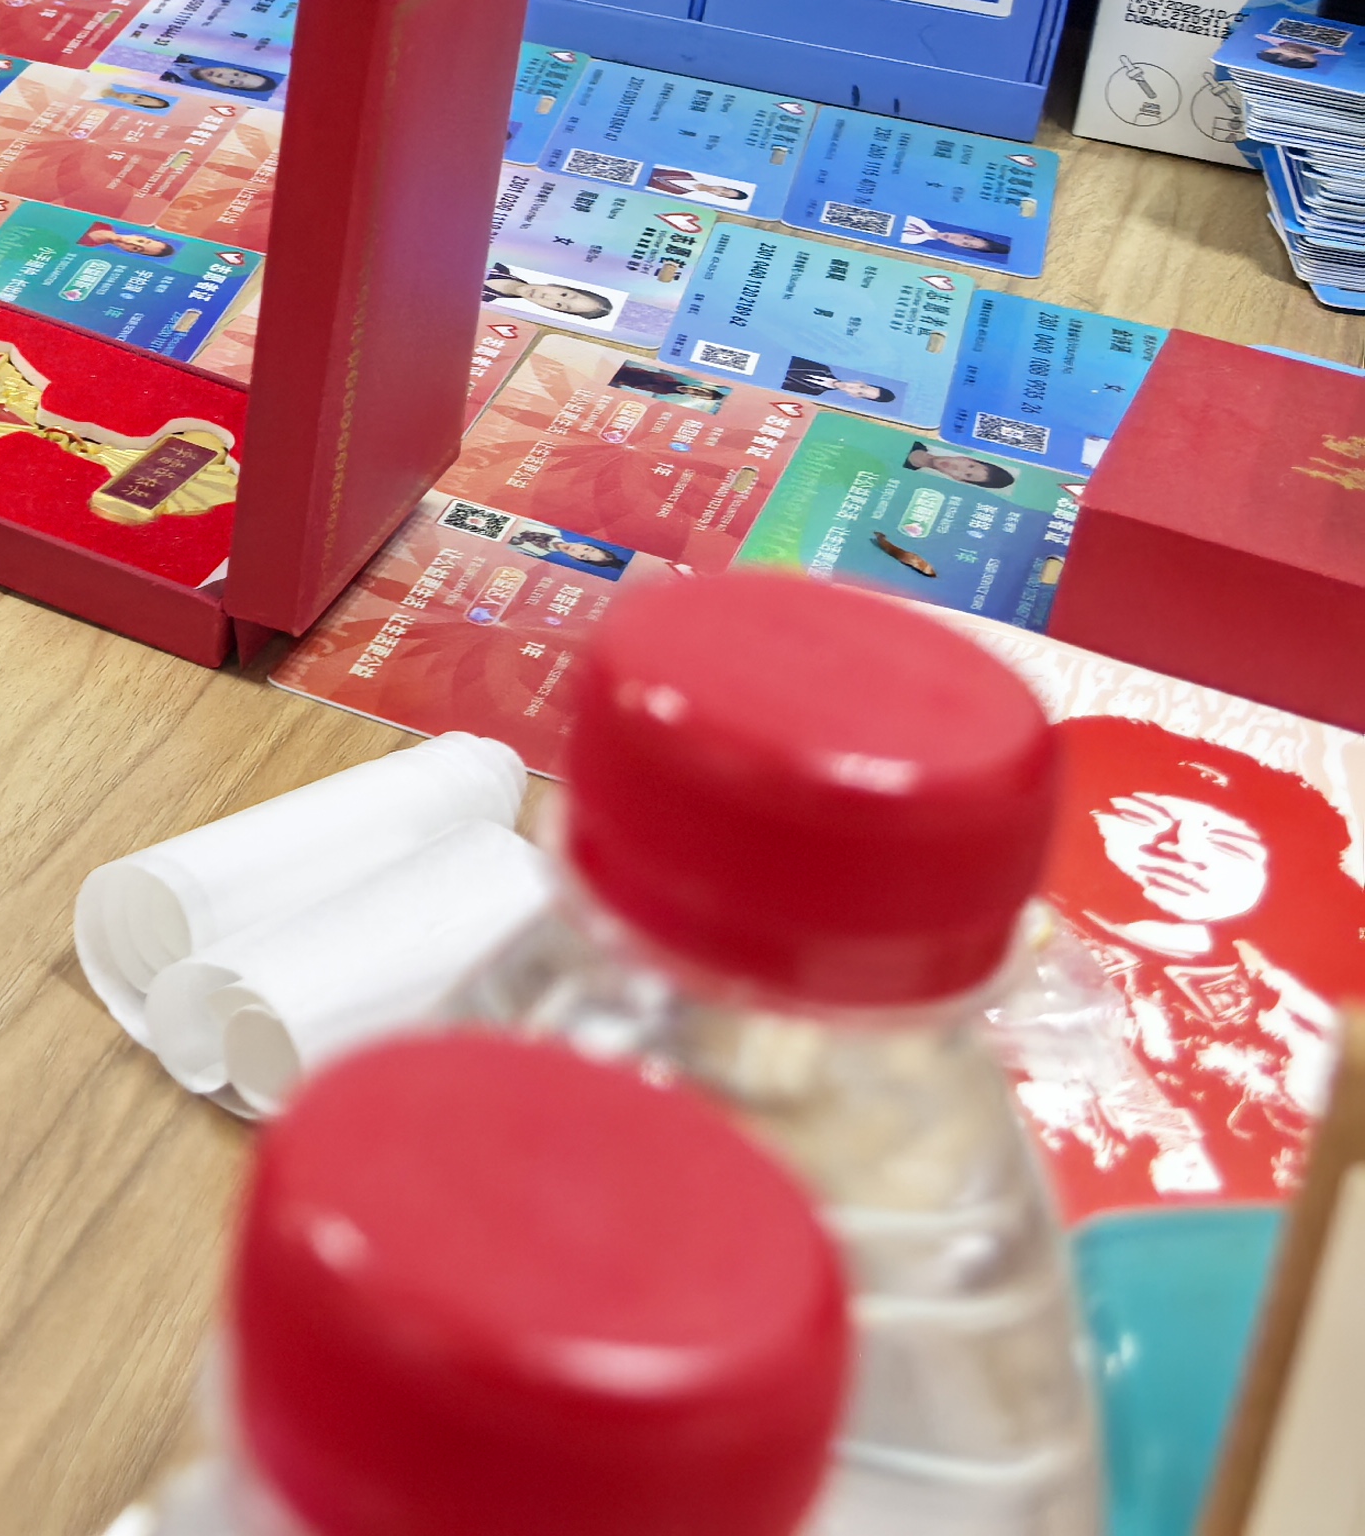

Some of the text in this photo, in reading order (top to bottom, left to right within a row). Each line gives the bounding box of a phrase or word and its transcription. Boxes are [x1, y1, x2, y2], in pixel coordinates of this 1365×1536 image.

[182, 114, 226, 146] 志愿者证
[103, 149, 127, 161] 1年
[495, 174, 529, 212] 2301 0200
[551, 234, 575, 247] 女
[186, 262, 234, 302] 志愿者证
[726, 242, 777, 327] 2301 0400 1120 2189 62
[812, 307, 833, 318] 男
[1035, 311, 1058, 331] 2301
[1031, 332, 1055, 355] 0400
[1101, 382, 1125, 393] 女
[1018, 401, 1039, 414] 26
[743, 413, 790, 459] 志愿者证
[649, 460, 676, 477] 1年
[478, 568, 521, 609] 公益达人
[516, 638, 546, 659] 1年
